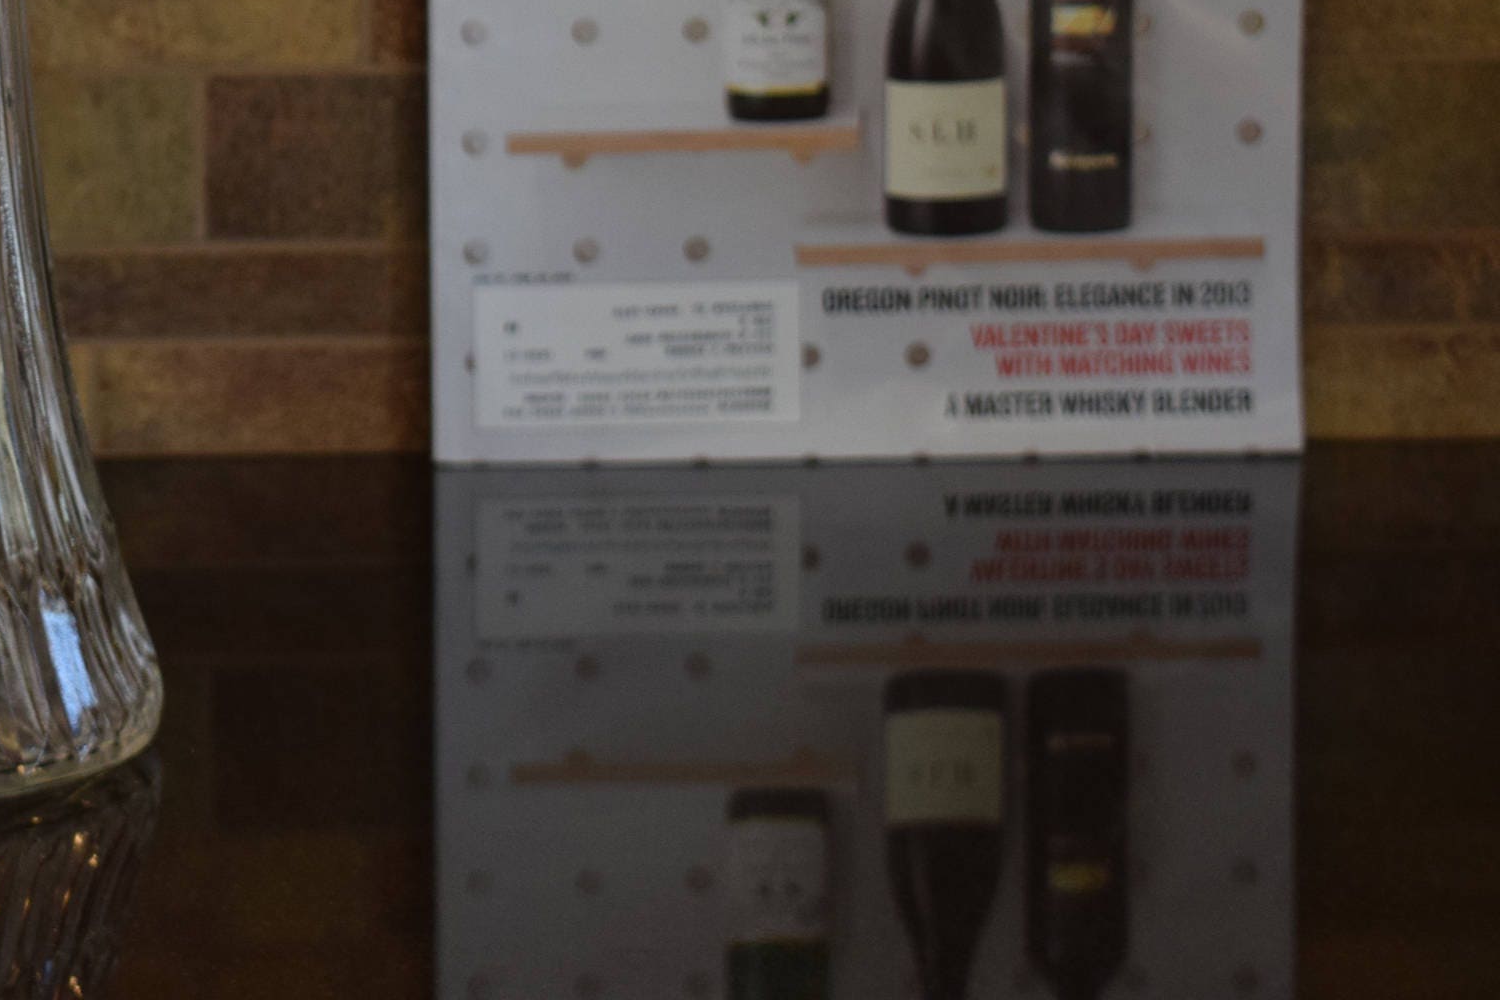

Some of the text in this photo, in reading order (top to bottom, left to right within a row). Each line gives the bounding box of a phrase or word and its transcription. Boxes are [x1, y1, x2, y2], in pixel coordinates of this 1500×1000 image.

[822, 288, 913, 313] OREGON
[917, 285, 982, 310] PINOT
[1054, 282, 1165, 309] ELEGANCE
[1171, 283, 1195, 306] IN
[1200, 281, 1251, 307] 2013
[1115, 322, 1156, 346] DAY
[1164, 321, 1249, 345] SWEETS
[996, 349, 1250, 377] WITH MATCHING WINES
[945, 389, 1253, 417] A MASTER WHISKY BLENDER
